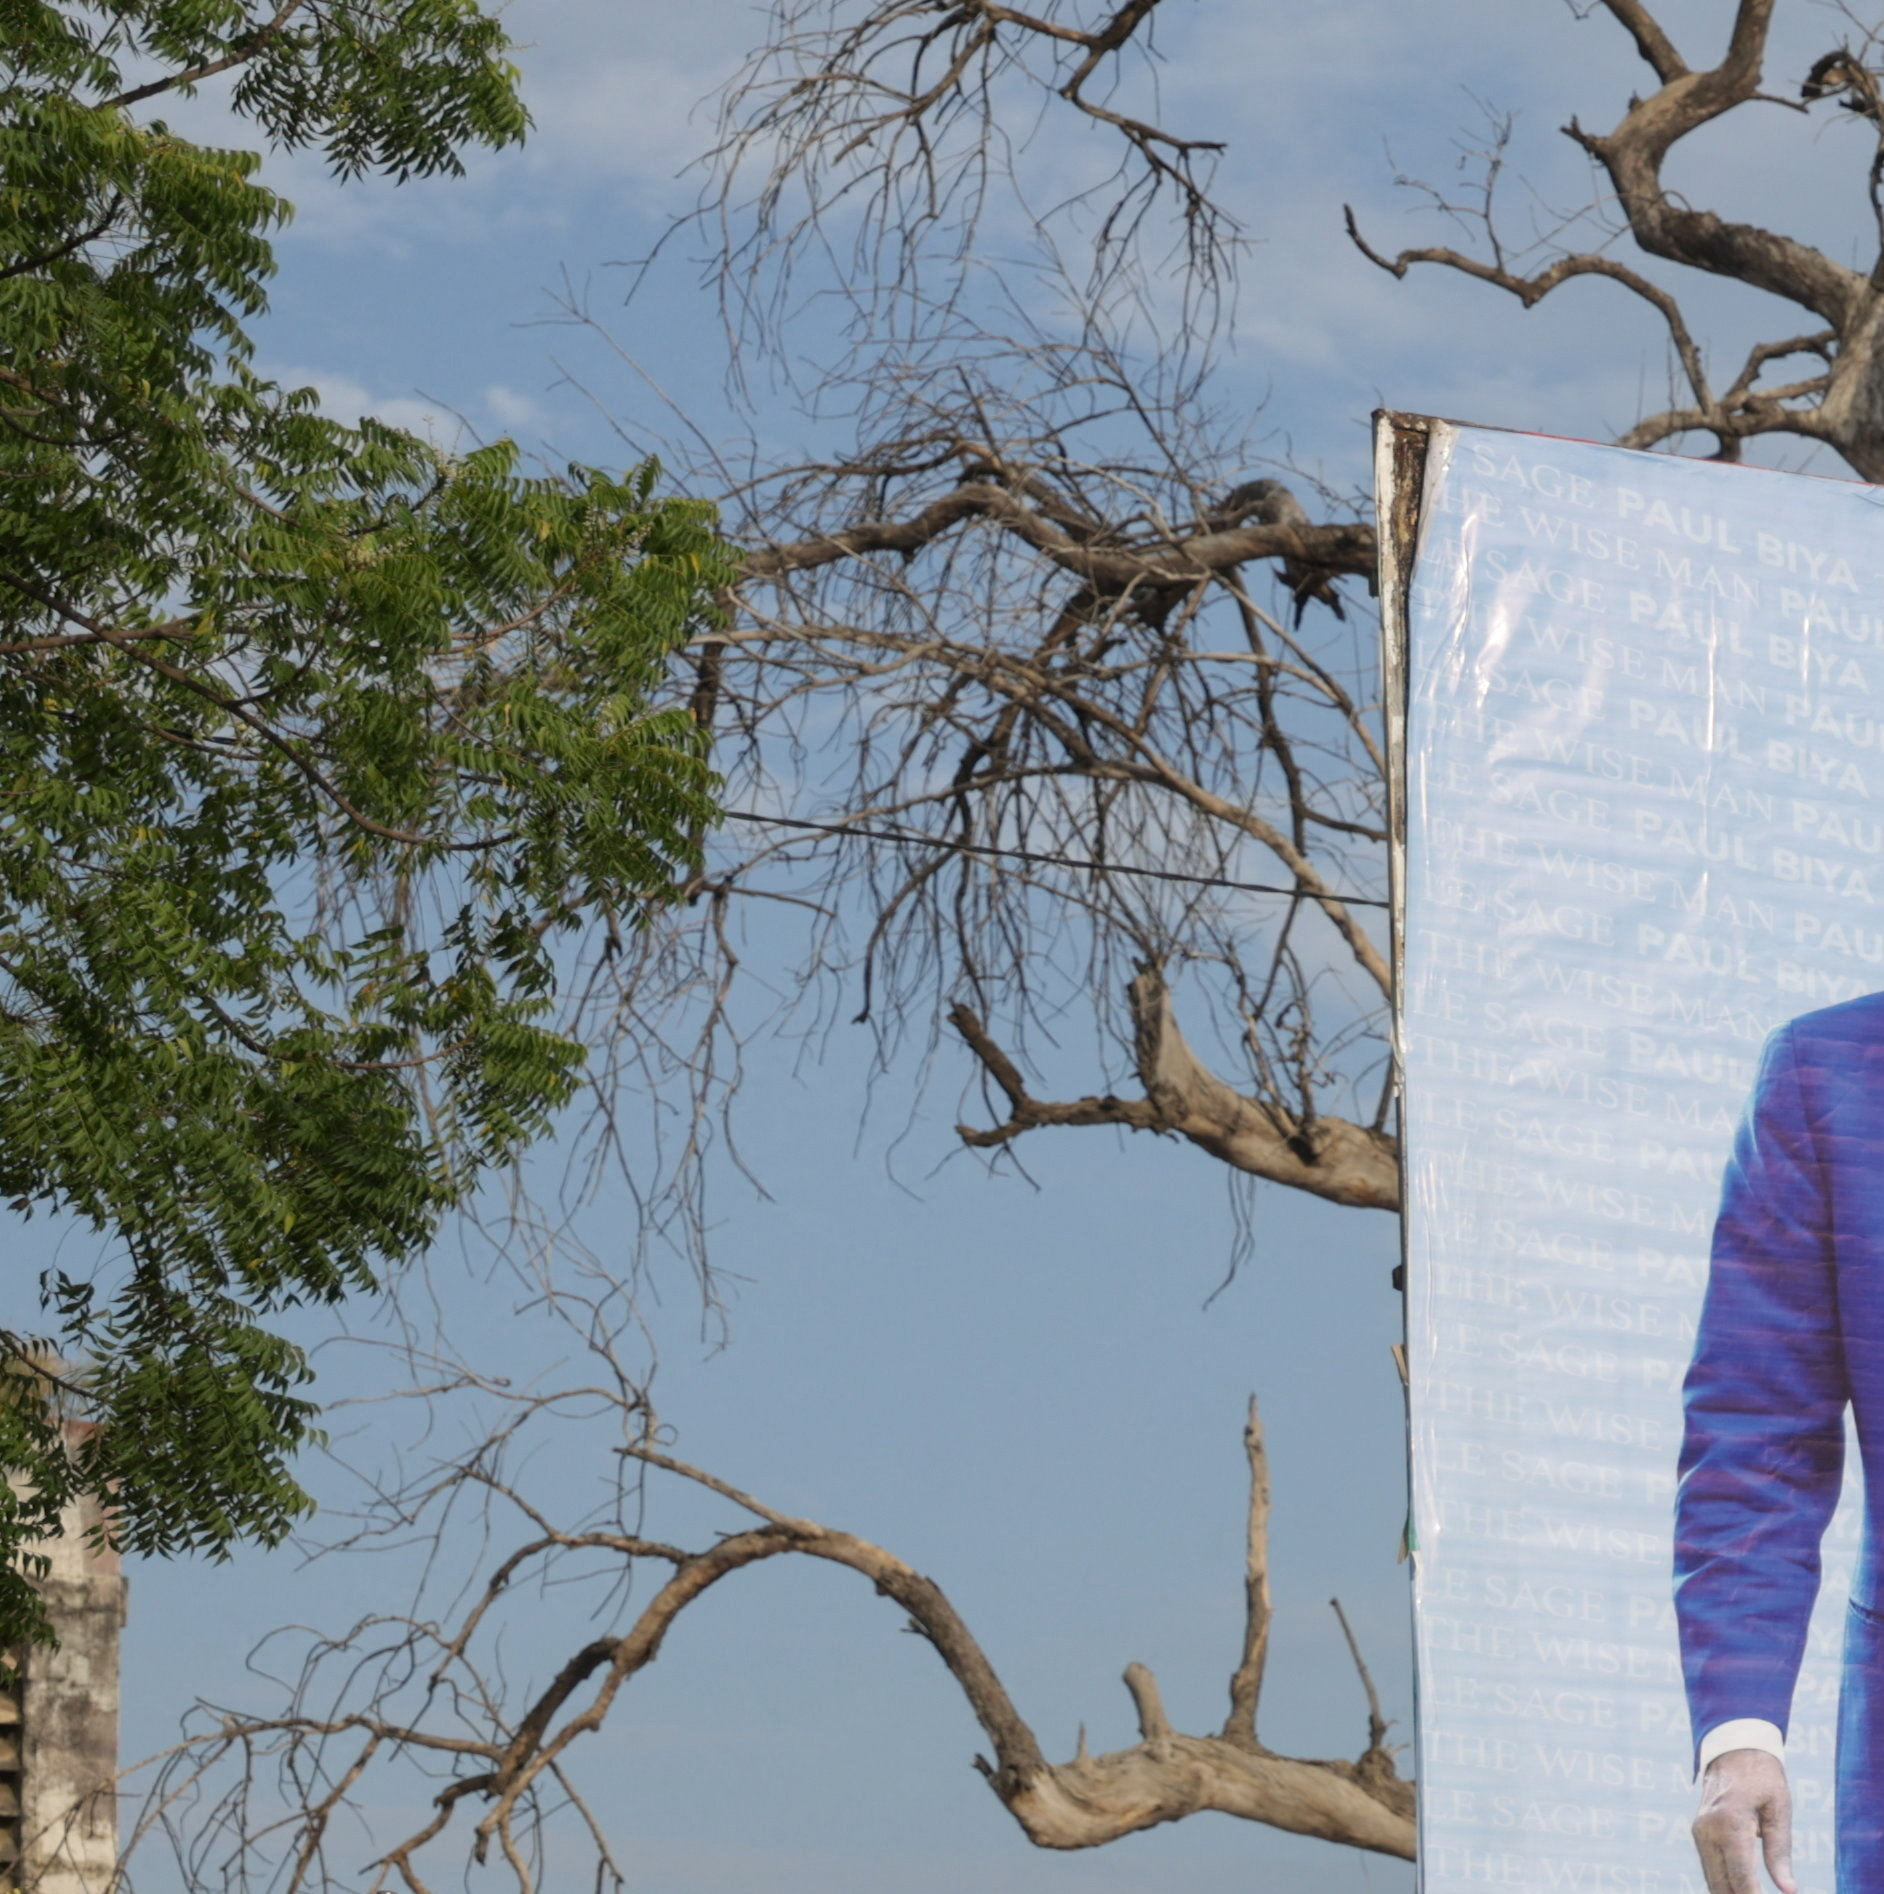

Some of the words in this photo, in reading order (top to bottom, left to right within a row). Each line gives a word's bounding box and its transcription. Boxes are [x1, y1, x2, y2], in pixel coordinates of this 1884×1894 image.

[1471, 444, 1594, 510] SAGE
[1618, 488, 1740, 553] PAUL
[1758, 532, 1859, 593] BIYA
[1520, 506, 1639, 570] WISE
[1656, 548, 1759, 608] MAN
[1528, 616, 1647, 679] WISE
[1629, 590, 1754, 658] PAUL
[1544, 1283, 1662, 1336] WISE
[1499, 1332, 1620, 1383] SAGE
